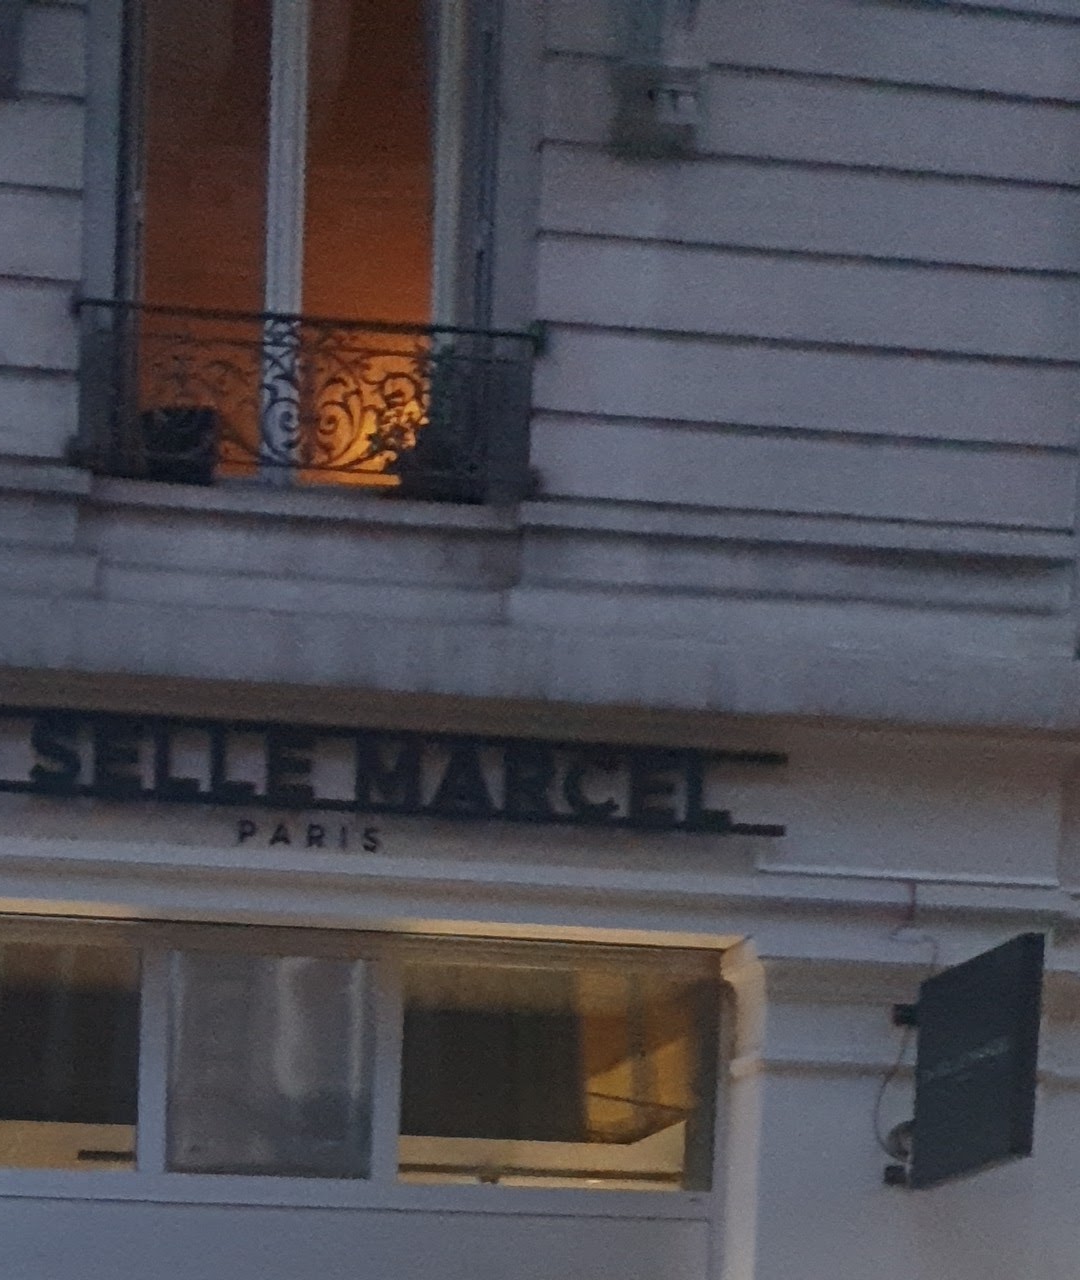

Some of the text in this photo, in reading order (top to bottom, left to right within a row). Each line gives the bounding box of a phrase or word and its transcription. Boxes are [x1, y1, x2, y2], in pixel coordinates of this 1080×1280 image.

[29, 710, 314, 810] SELLE
[354, 726, 732, 832] MARCEL
[236, 819, 382, 853] PARIS
